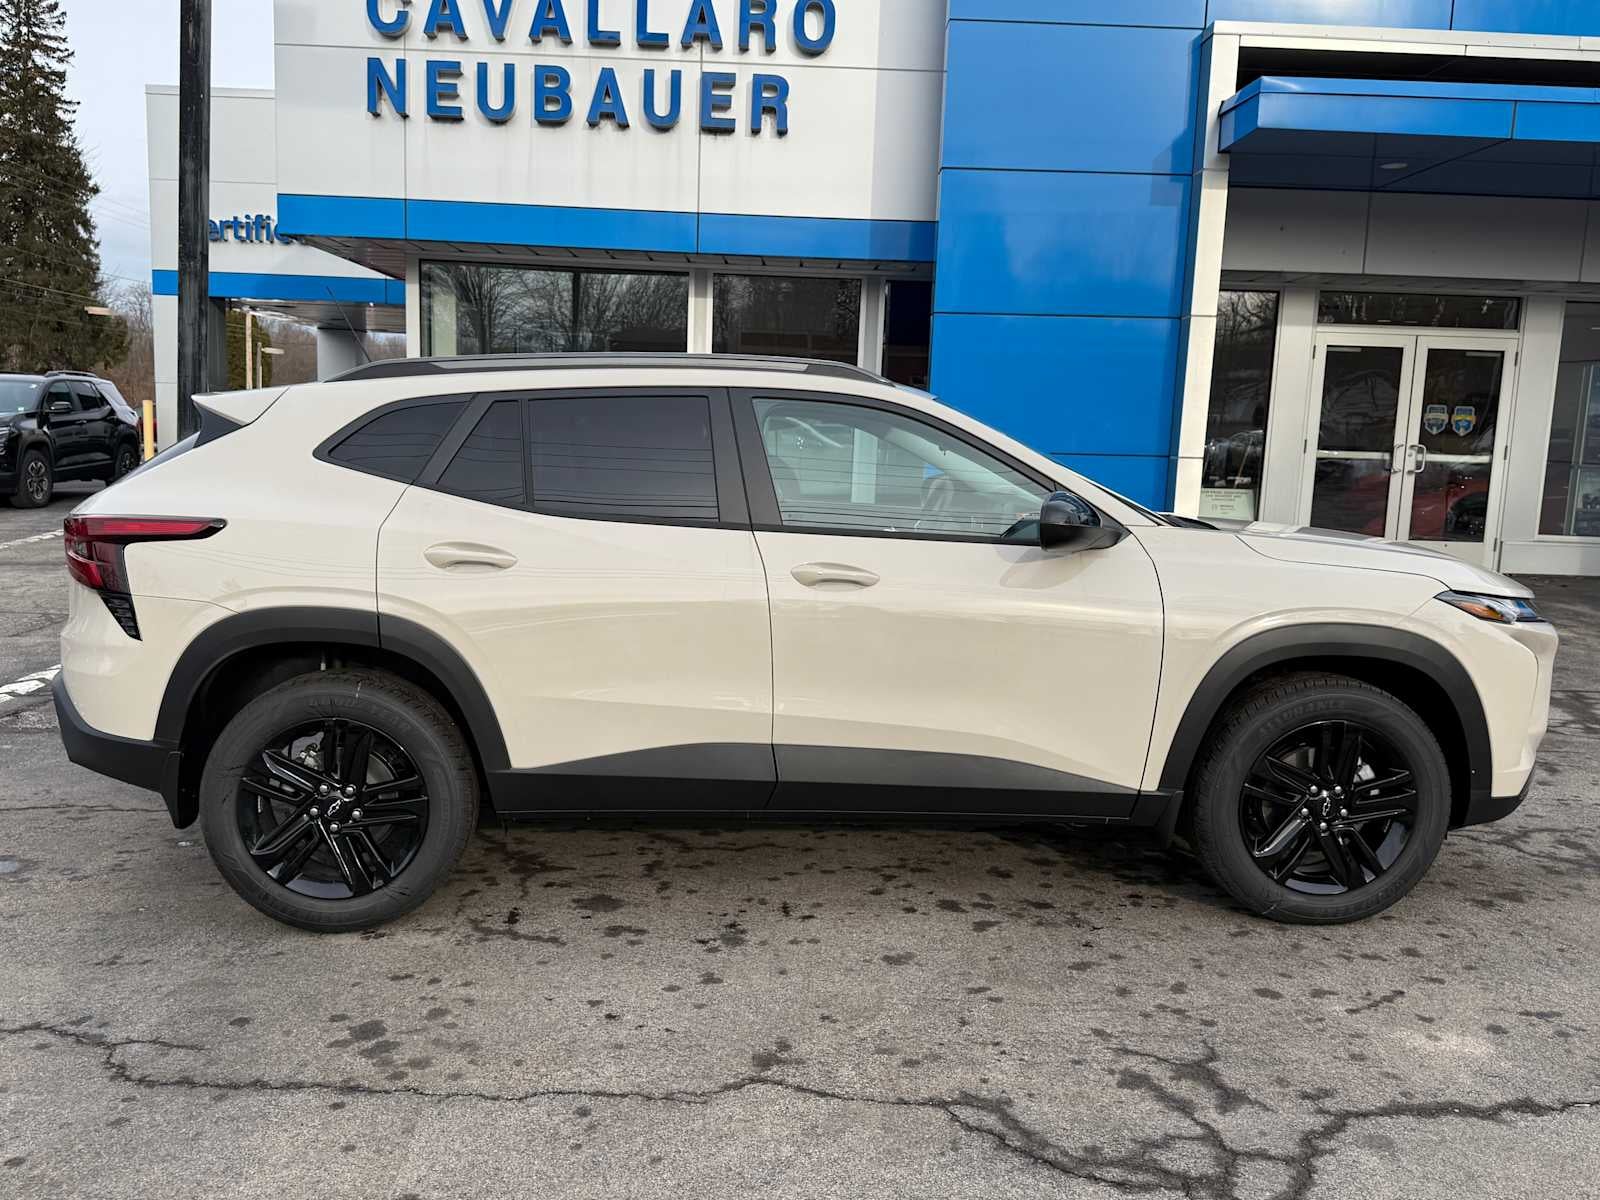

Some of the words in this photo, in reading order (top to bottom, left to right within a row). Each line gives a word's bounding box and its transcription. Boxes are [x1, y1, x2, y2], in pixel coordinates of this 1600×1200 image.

[366, 0, 836, 54] CAVALLARO
[367, 57, 789, 136] NEUBAUER
[208, 214, 294, 245] ertifi
